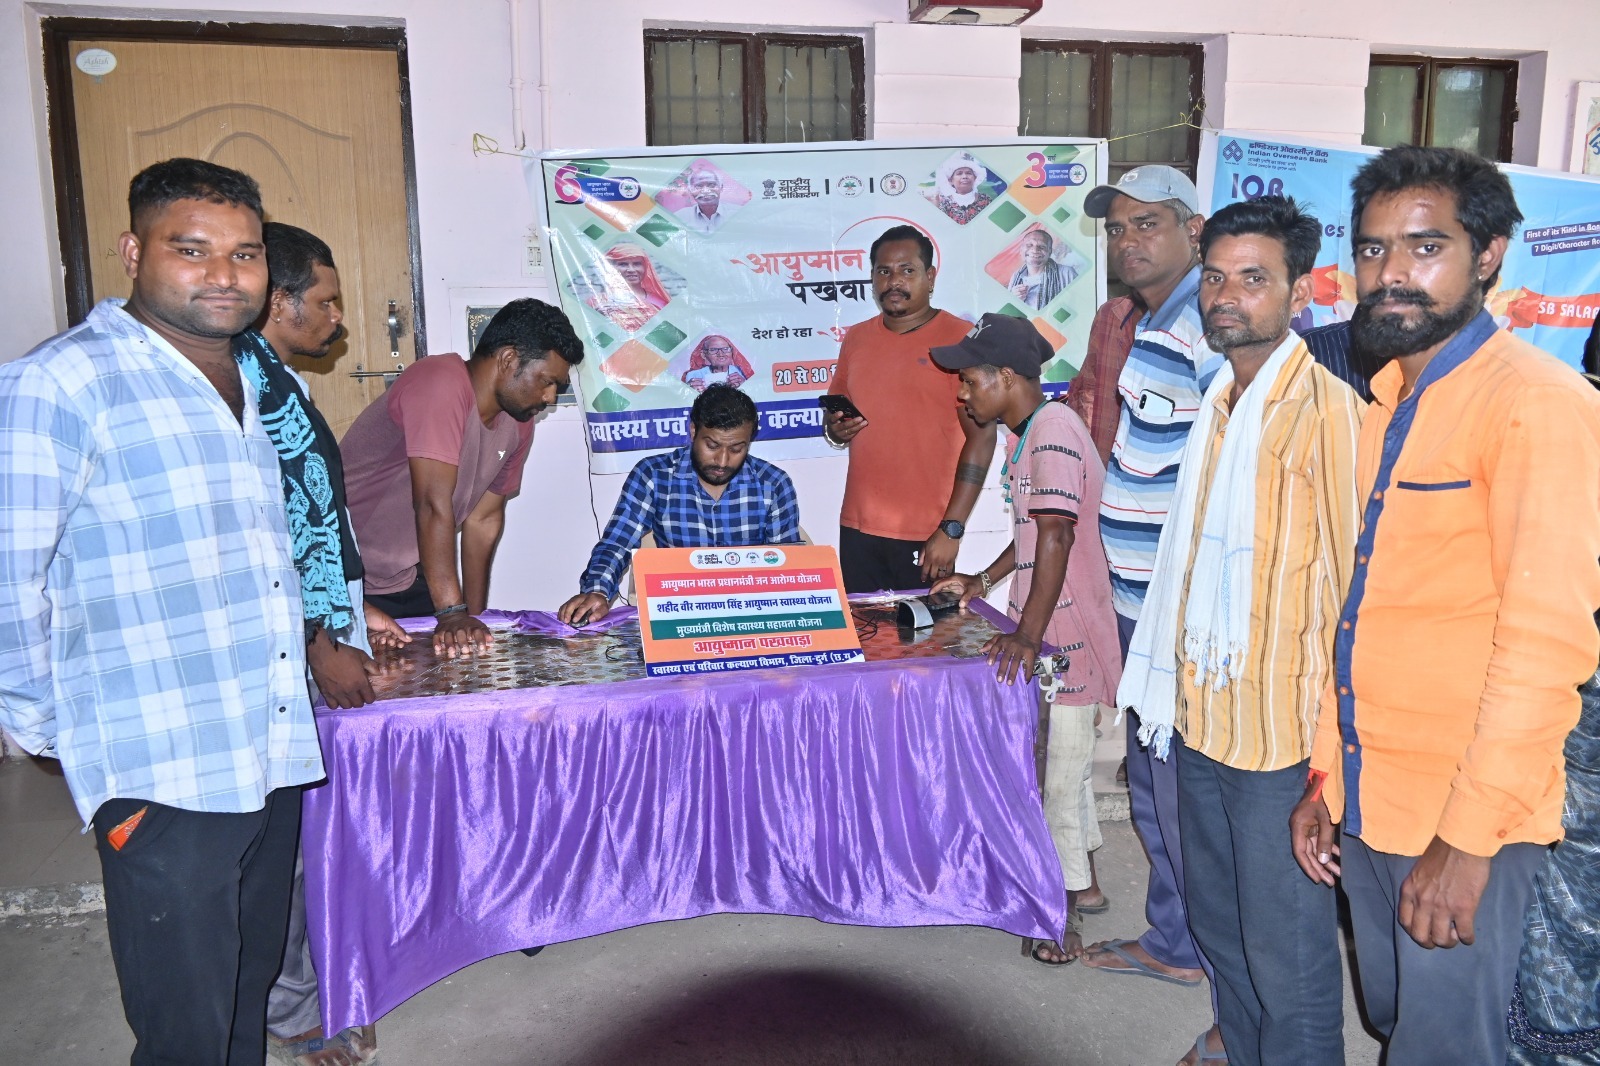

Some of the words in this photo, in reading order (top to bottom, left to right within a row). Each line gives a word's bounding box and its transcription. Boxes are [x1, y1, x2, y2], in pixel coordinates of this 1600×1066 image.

[1247, 149, 1271, 157] Indian
[1272, 152, 1308, 161] Overseas
[1025, 152, 1047, 187] 3
[554, 165, 581, 203] 6
[1231, 172, 1284, 202] IOB
[1526, 230, 1541, 239] First
[1542, 228, 1550, 237] of
[1551, 227, 1560, 236] its
[1561, 225, 1578, 234] Kind
[1579, 224, 1587, 232] in
[1587, 223, 1600, 231] Ban
[1540, 239, 1590, 252] Digit/Character
[734, 249, 867, 281] आयुष्मान
[785, 279, 873, 304] पखवा
[1538, 301, 1556, 315] SB
[1560, 303, 1600, 319] SALAR
[751, 327, 773, 340] देश
[776, 326, 790, 339] हो
[793, 327, 813, 338] रहा
[775, 370, 792, 386] 20
[795, 366, 809, 384] से
[811, 368, 828, 384] 30
[589, 419, 650, 441] स्वास्थ्य
[652, 410, 689, 437] एवं
[765, 407, 824, 429] कल्या
[661, 580, 695, 591] आयुष्मान
[697, 578, 716, 587] भारत
[717, 575, 754, 587] प्रधानमंत्री
[755, 576, 768, 585] जन
[770, 573, 796, 585] आरोग्य
[797, 572, 821, 583] योजना
[657, 601, 679, 613] शहीद
[680, 601, 693, 611] वीर
[695, 601, 726, 611] नारायण
[727, 598, 743, 609] सिंह
[744, 599, 778, 611] आयुष्मान
[779, 597, 806, 606] स्वास्थ्य
[808, 595, 832, 605] योजना
[676, 623, 711, 637] मुख्यमंत्री
[712, 621, 736, 632] विशेष
[737, 621, 765, 631] स्वास्थ्य
[766, 619, 796, 629] सहायता
[797, 616, 822, 628] योजना
[694, 638, 757, 656] आयुष्मान
[759, 634, 812, 648] पखवाड़ा
[652, 665, 681, 675] स्वास्थ्य
[682, 662, 696, 672] एवं
[697, 661, 724, 671] परिवार
[725, 659, 758, 669] कल्याण
[759, 656, 788, 667] विभाग,
[789, 652, 828, 665] जिला-दुर्ग
